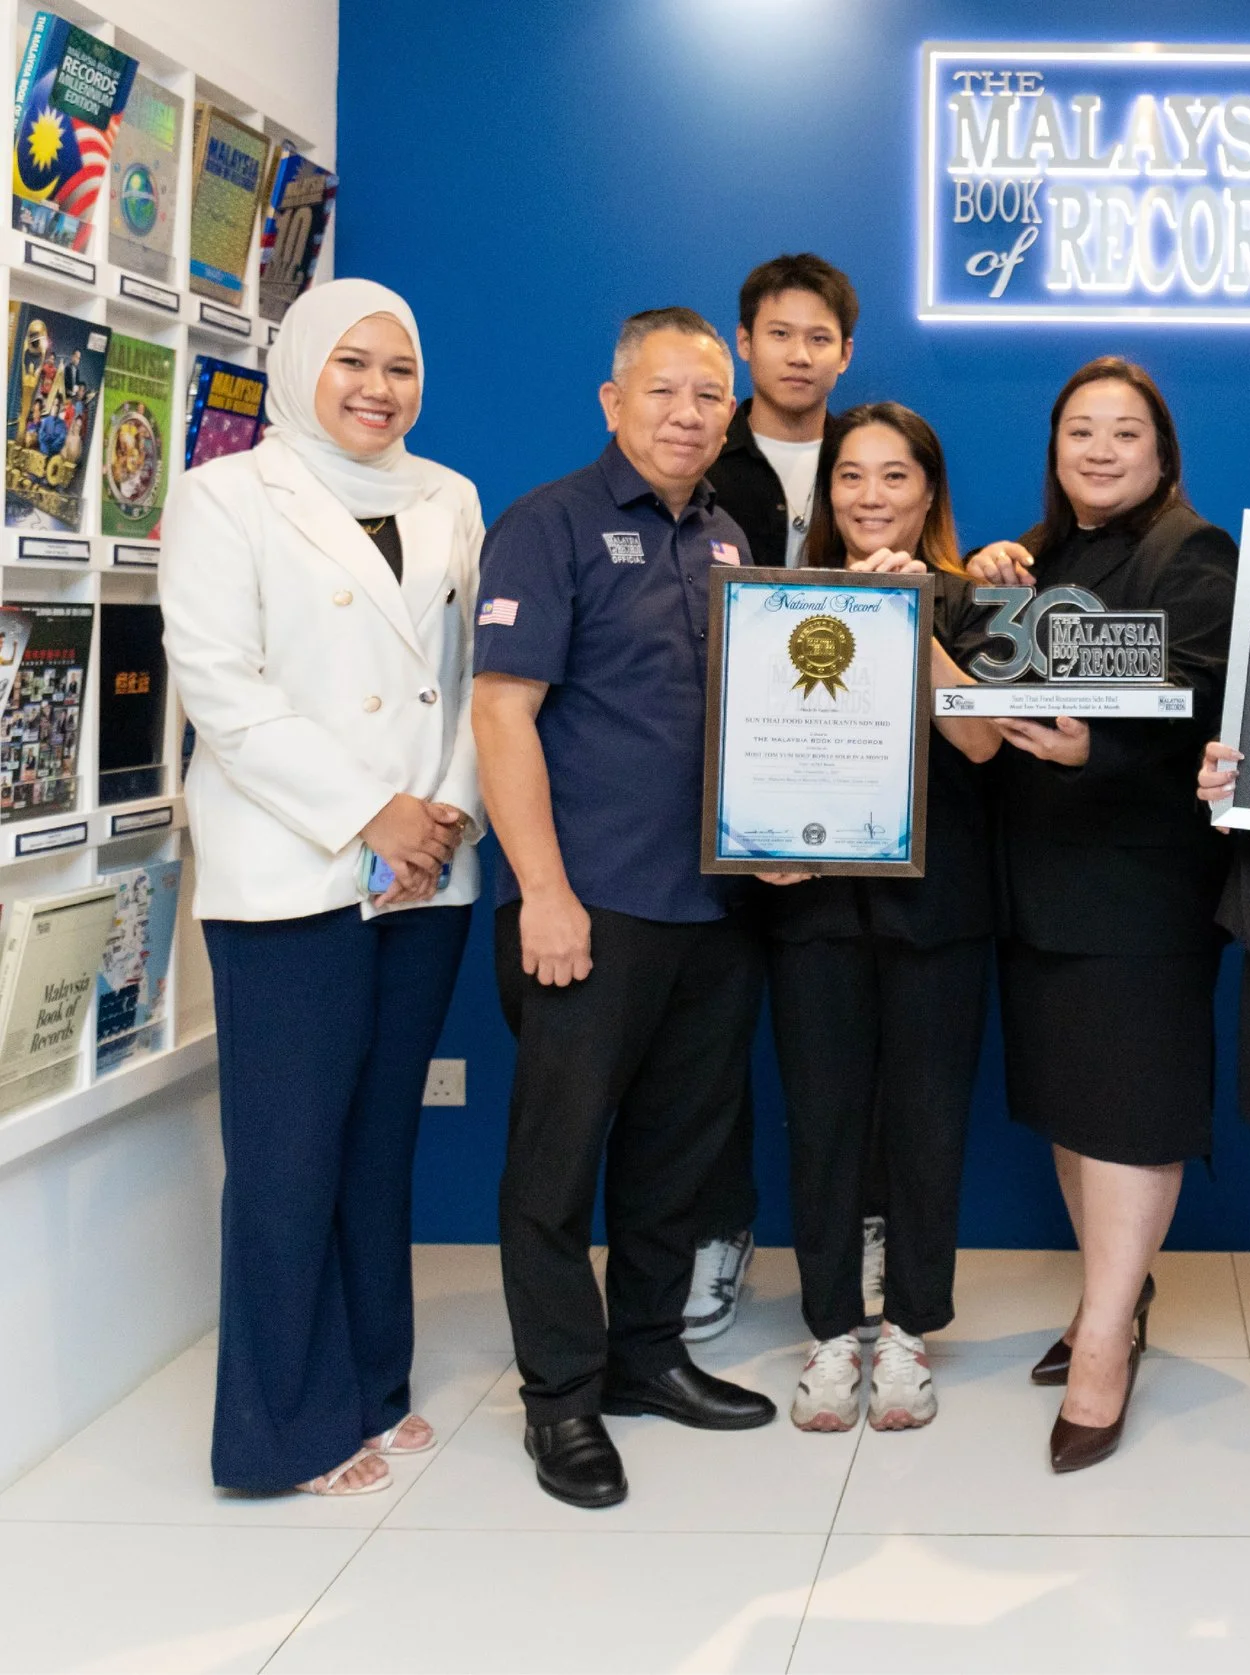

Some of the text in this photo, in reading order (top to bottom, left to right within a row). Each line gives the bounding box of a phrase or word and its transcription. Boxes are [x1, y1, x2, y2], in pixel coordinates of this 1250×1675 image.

[23, 33, 42, 78] MALAYSIA
[58, 72, 114, 108] MILLENNIUM
[62, 55, 119, 96] RECORDS
[953, 71, 1044, 97] THE
[64, 89, 101, 116] EDITION
[953, 178, 1043, 224] BOOK
[965, 227, 1040, 298] of
[611, 555, 646, 564] OFFICIAL
[764, 588, 883, 613] National Record
[1053, 623, 1160, 646] MALAYSIA
[1053, 645, 1079, 659] BOOK
[1079, 647, 1160, 676] RECORDS
[1056, 658, 1078, 678] of
[44, 972, 91, 1003] Malaysia
[36, 1001, 63, 1029] Book
[65, 994, 82, 1018] of
[30, 1019, 74, 1054] Records
